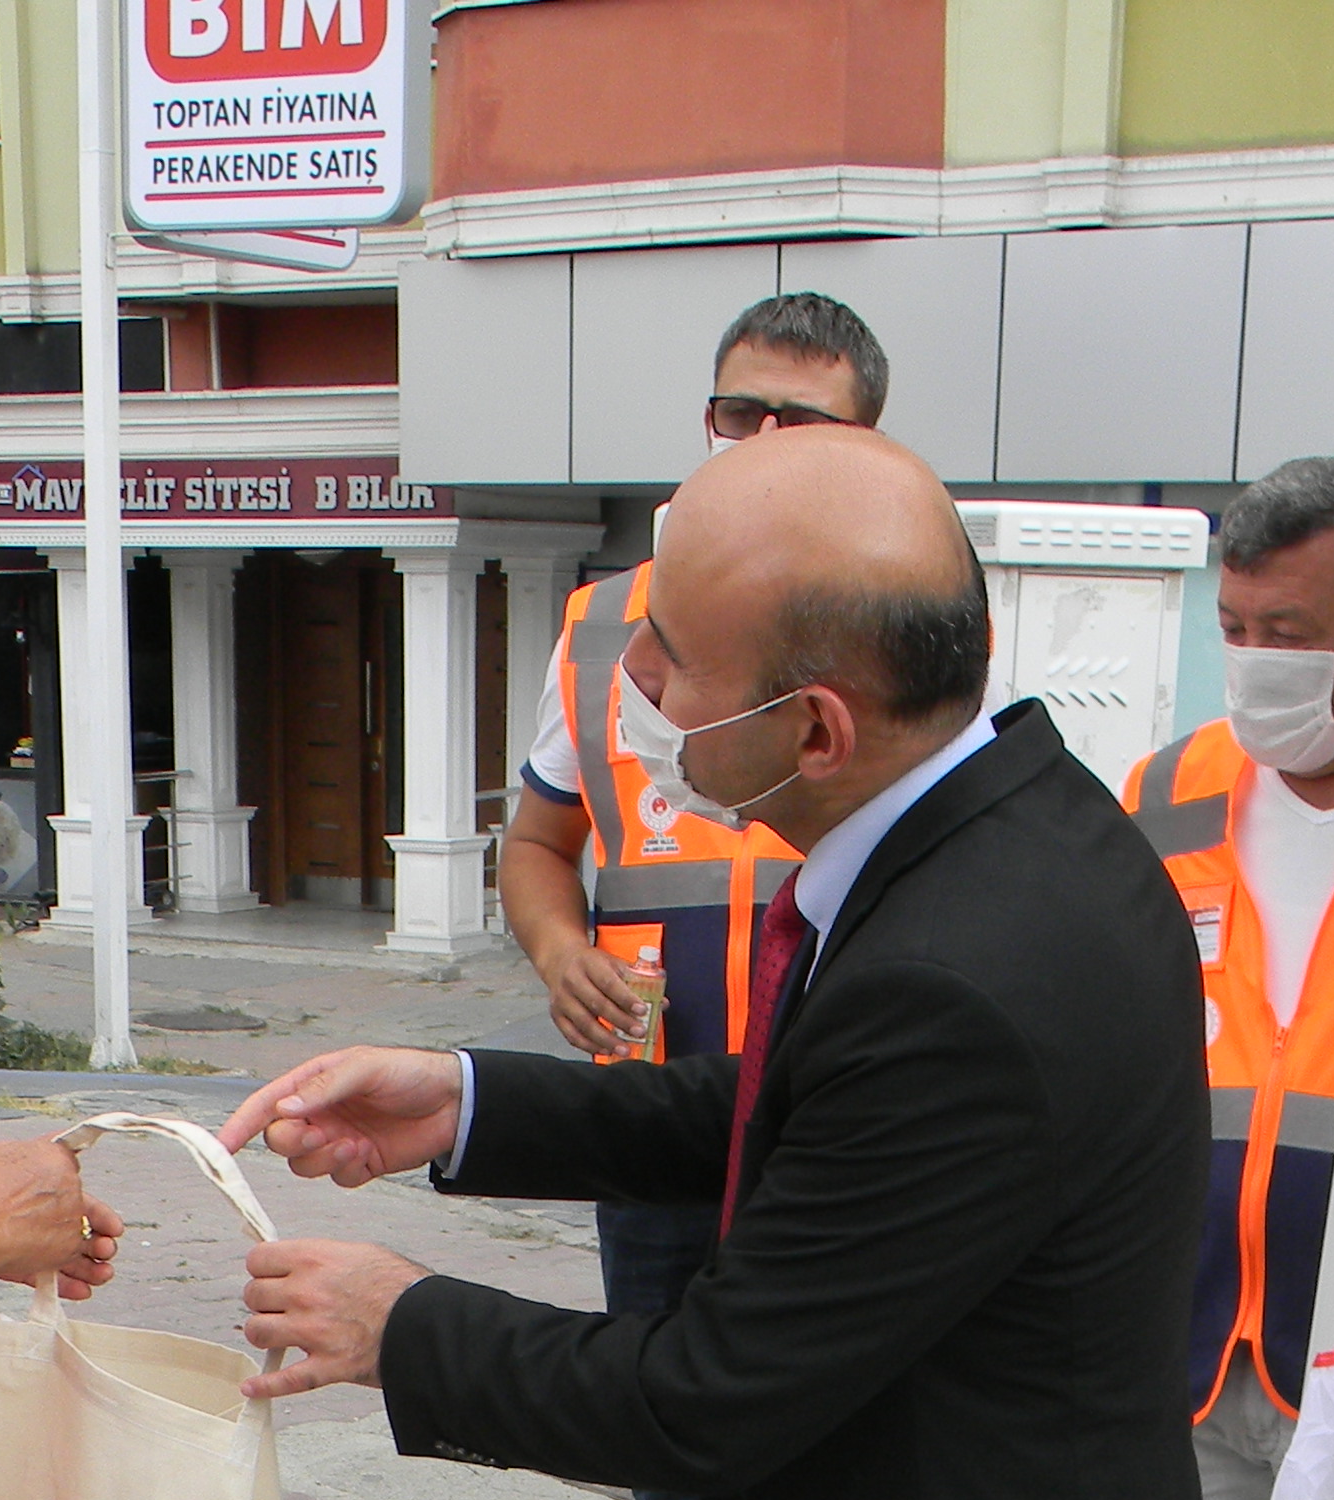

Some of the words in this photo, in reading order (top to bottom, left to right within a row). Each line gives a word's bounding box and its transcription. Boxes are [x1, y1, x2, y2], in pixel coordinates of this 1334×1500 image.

[153, 98, 251, 130] TOPTAN
[263, 87, 378, 126] FİYATINA
[153, 152, 298, 185] PERAKENDE
[309, 148, 378, 185] SATIŞ
[185, 467, 292, 512] SİTESİ
[315, 476, 337, 511] B
